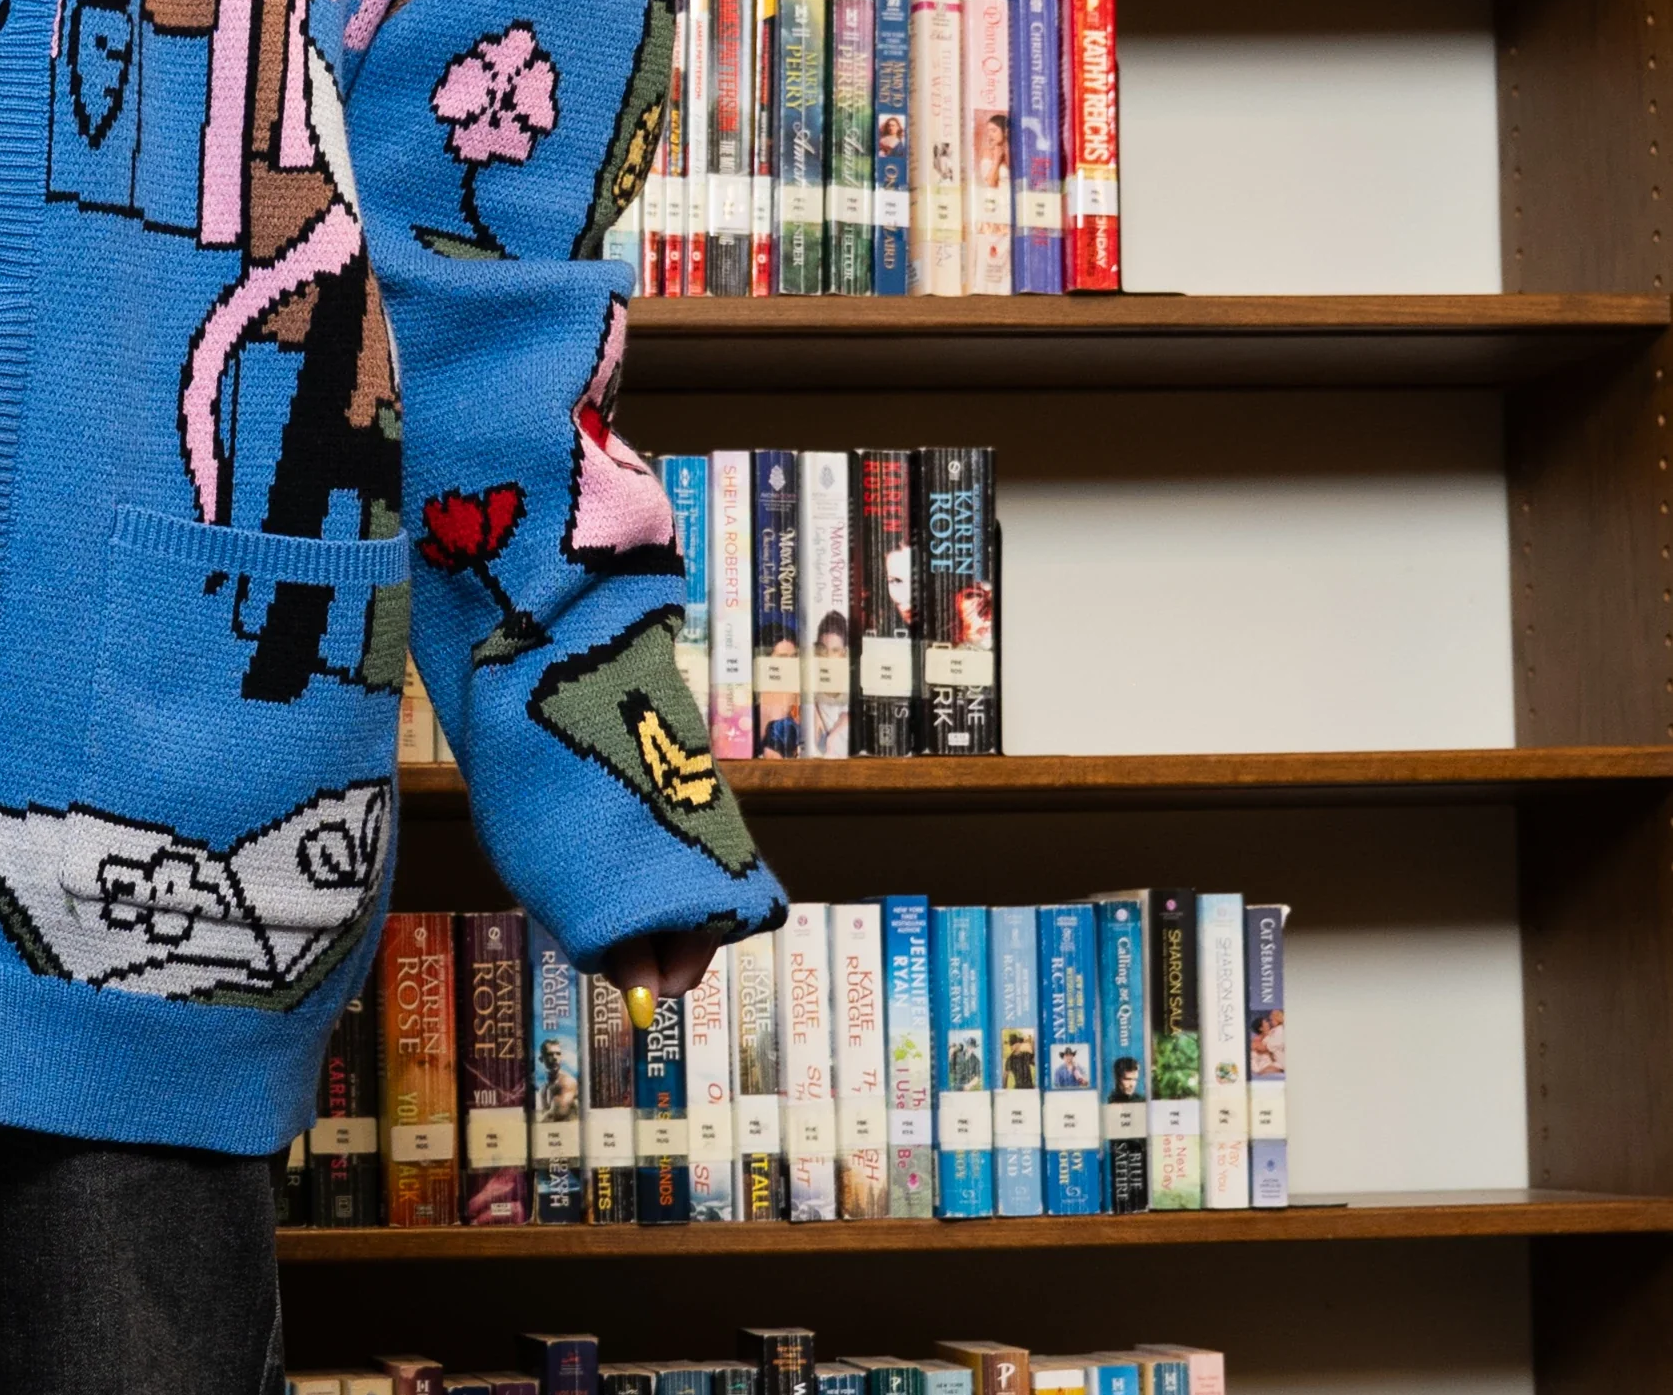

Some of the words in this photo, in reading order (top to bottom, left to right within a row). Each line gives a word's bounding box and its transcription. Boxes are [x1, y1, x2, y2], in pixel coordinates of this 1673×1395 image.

[1083, 30, 1107, 90] KATHY
[1084, 95, 1109, 161] REICHS
[724, 465, 737, 525] SHEILA
[929, 492, 951, 574] ROSE
[955, 490, 973, 575] KAREN
[725, 532, 737, 608] ROBERTS
[1117, 938, 1131, 984] Calling
[473, 962, 495, 1058] ROSE
[496, 960, 514, 1058] KAREN
[847, 956, 861, 1048] RUGGLE
[860, 971, 874, 1031] KATIE
[1119, 1004, 1130, 1047] Quinn
